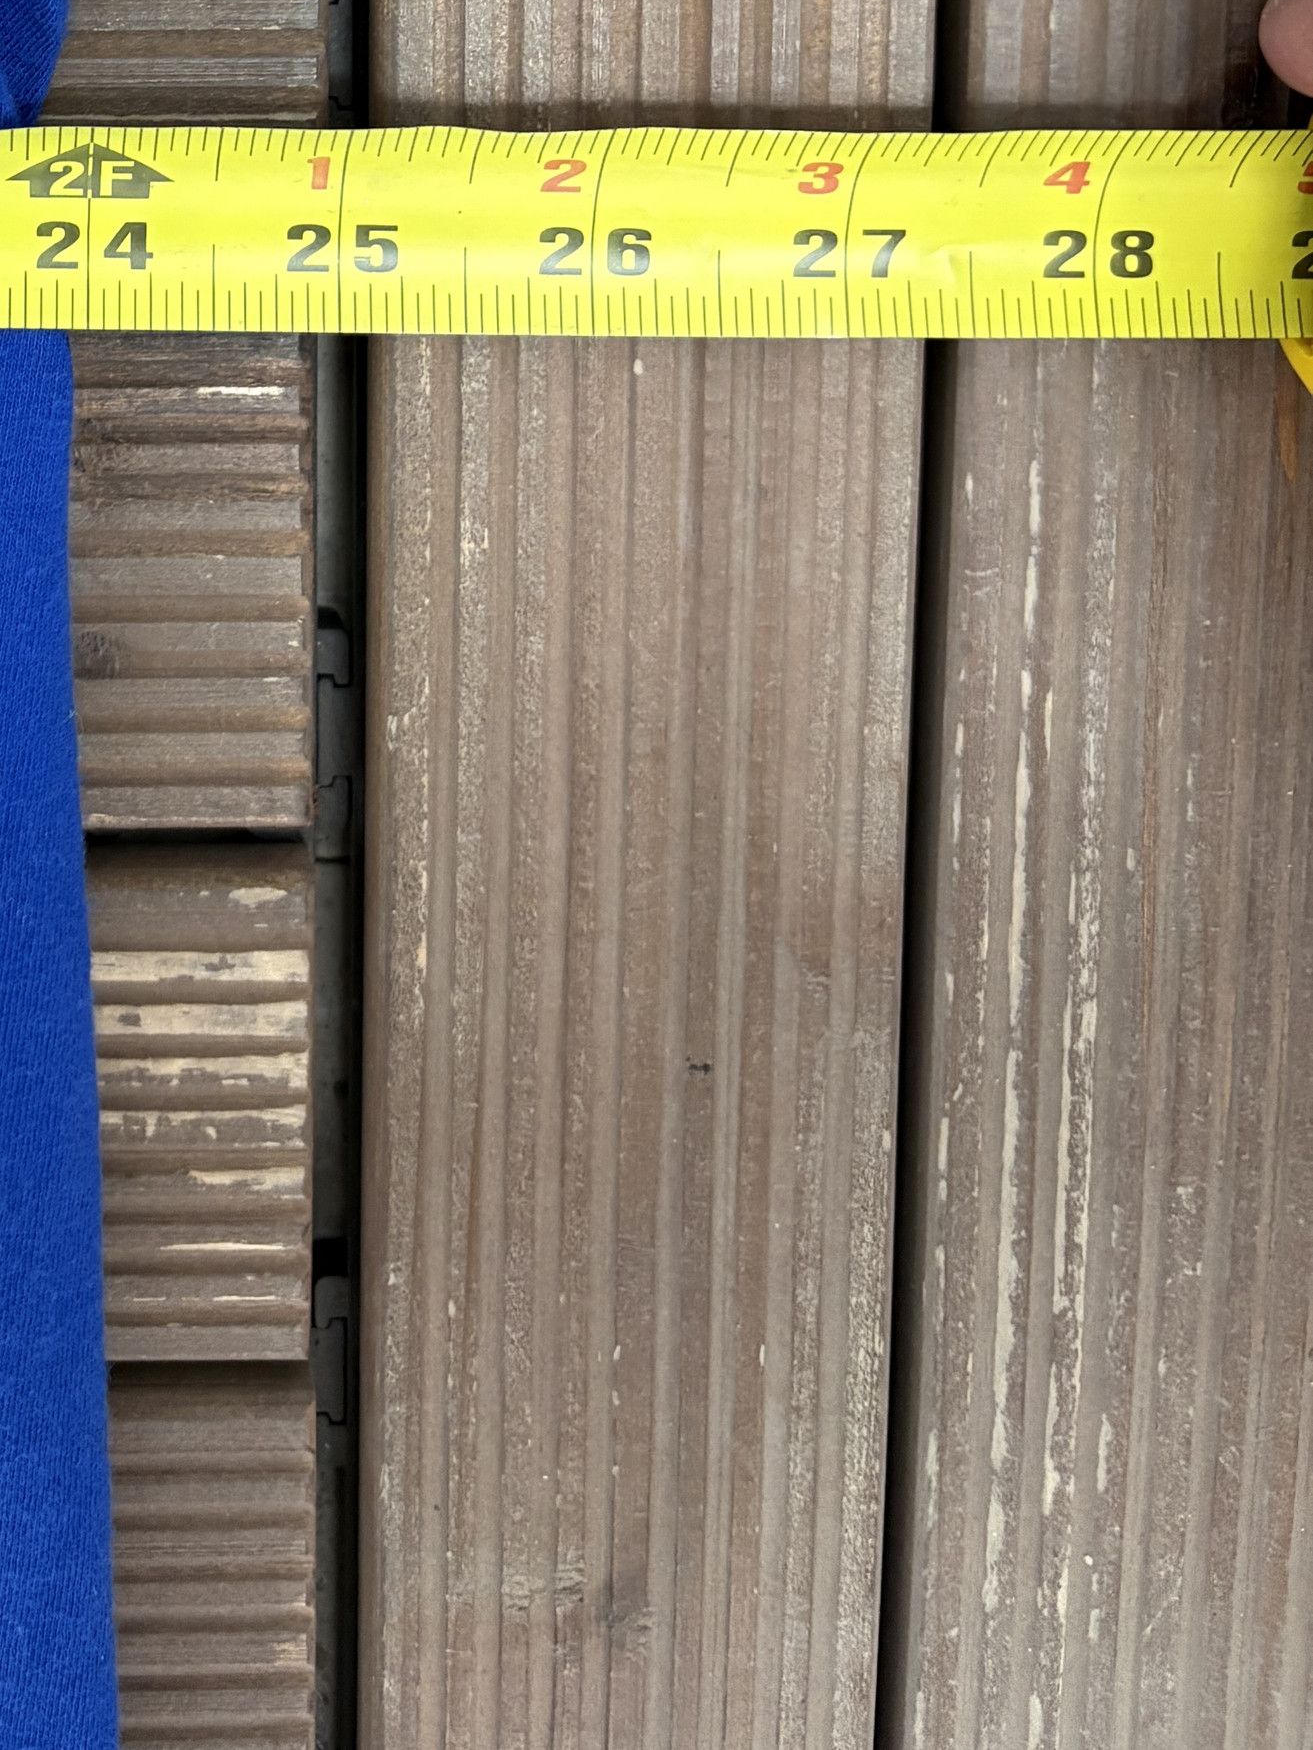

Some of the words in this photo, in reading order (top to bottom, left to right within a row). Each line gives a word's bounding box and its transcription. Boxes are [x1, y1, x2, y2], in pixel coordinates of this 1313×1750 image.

[49, 160, 135, 196] 2F
[307, 157, 331, 190] 1
[540, 159, 588, 192] 2
[798, 162, 844, 194] 3
[1043, 161, 1091, 194] 4
[36, 221, 154, 270] 24
[286, 224, 399, 273] 25
[538, 226, 651, 275] 26
[792, 229, 907, 278] 27
[1042, 230, 1155, 279] 28
